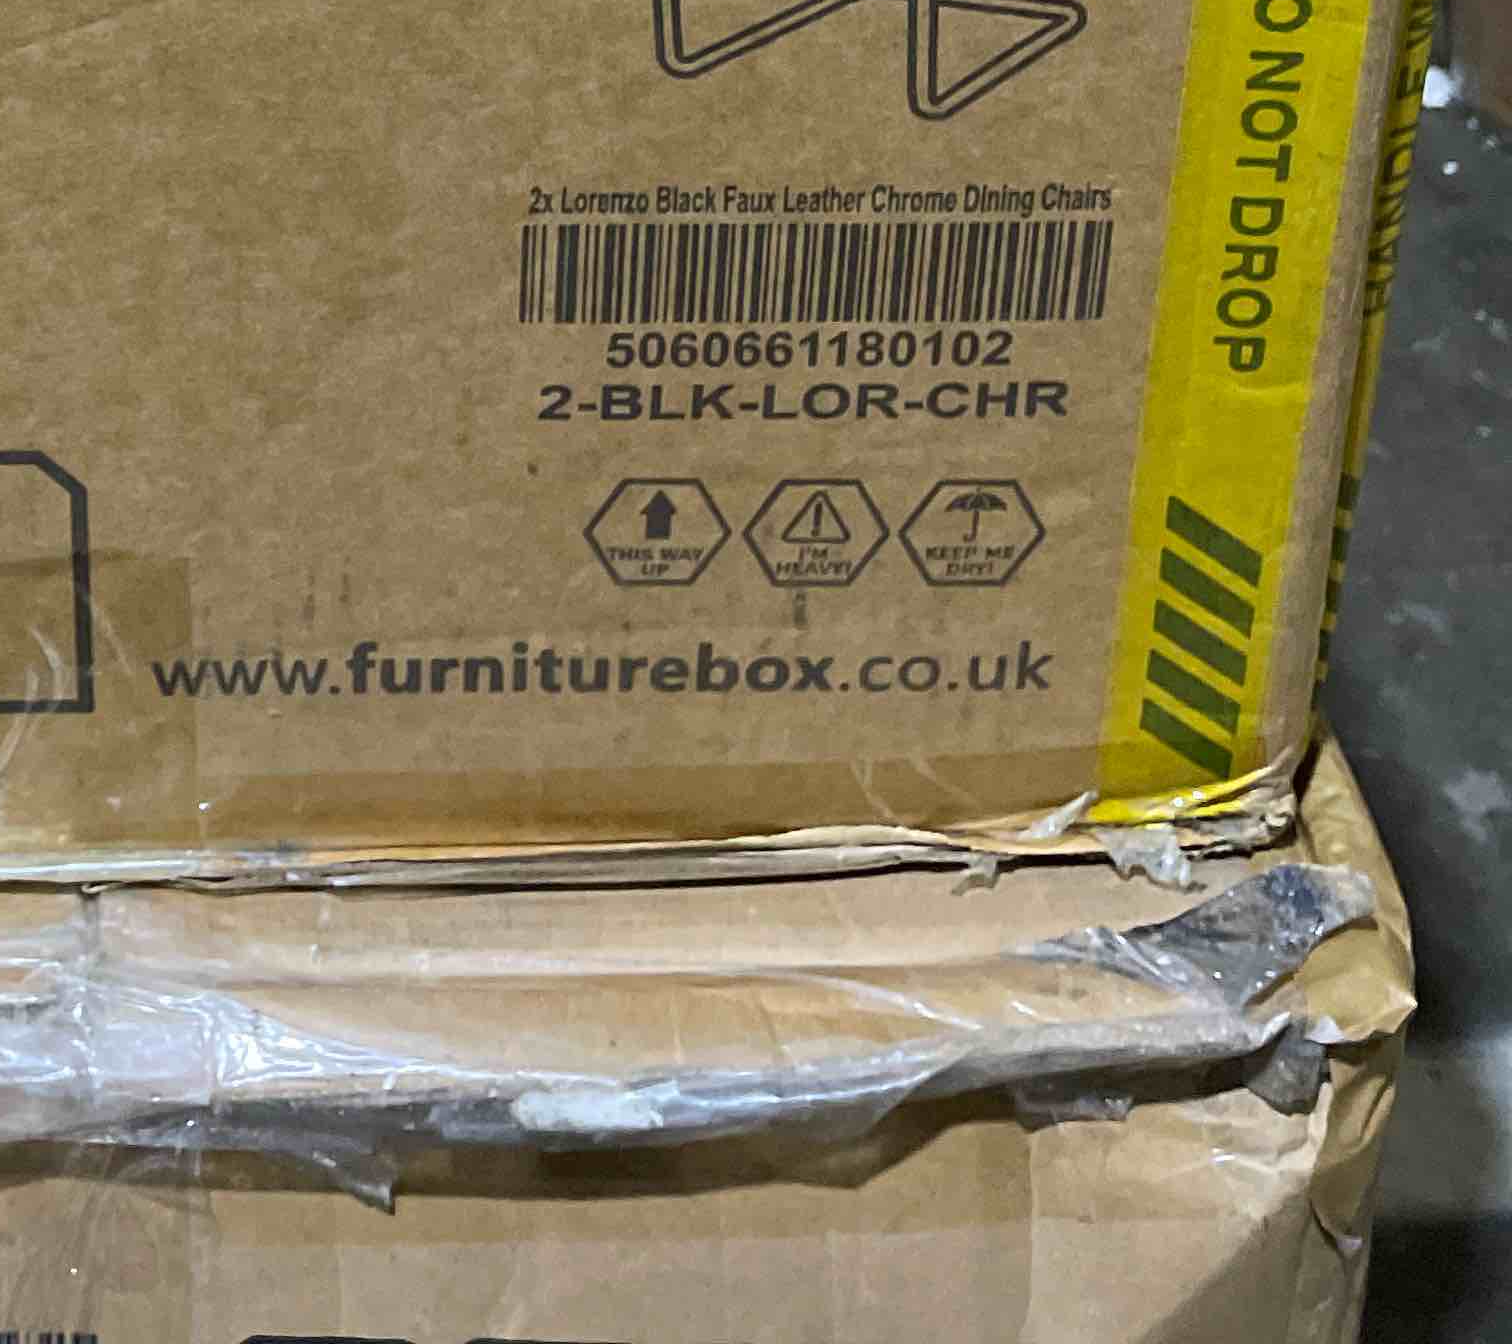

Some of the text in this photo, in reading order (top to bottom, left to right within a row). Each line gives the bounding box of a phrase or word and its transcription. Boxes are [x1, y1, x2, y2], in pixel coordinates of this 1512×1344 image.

[1234, 48, 1305, 174] NOT
[528, 188, 555, 215] 2x
[560, 187, 649, 215] Lorenzo
[656, 186, 717, 214] Black
[722, 186, 777, 214] Faux
[781, 185, 865, 214] Leather
[870, 184, 957, 213] Chrome
[1041, 183, 1113, 213] Chairs
[1212, 193, 1286, 376] DROP
[605, 330, 1014, 369] 5060661180102
[536, 380, 1070, 422] 2-BLK-LOR-CHR
[606, 548, 704, 561] THIS WAY
[641, 563, 670, 576] UP
[775, 561, 851, 576] HEAVY!
[798, 548, 829, 561] I'M
[926, 547, 1014, 561] KEEP ME
[151, 639, 1054, 698] www.furniturebox.co.uk
